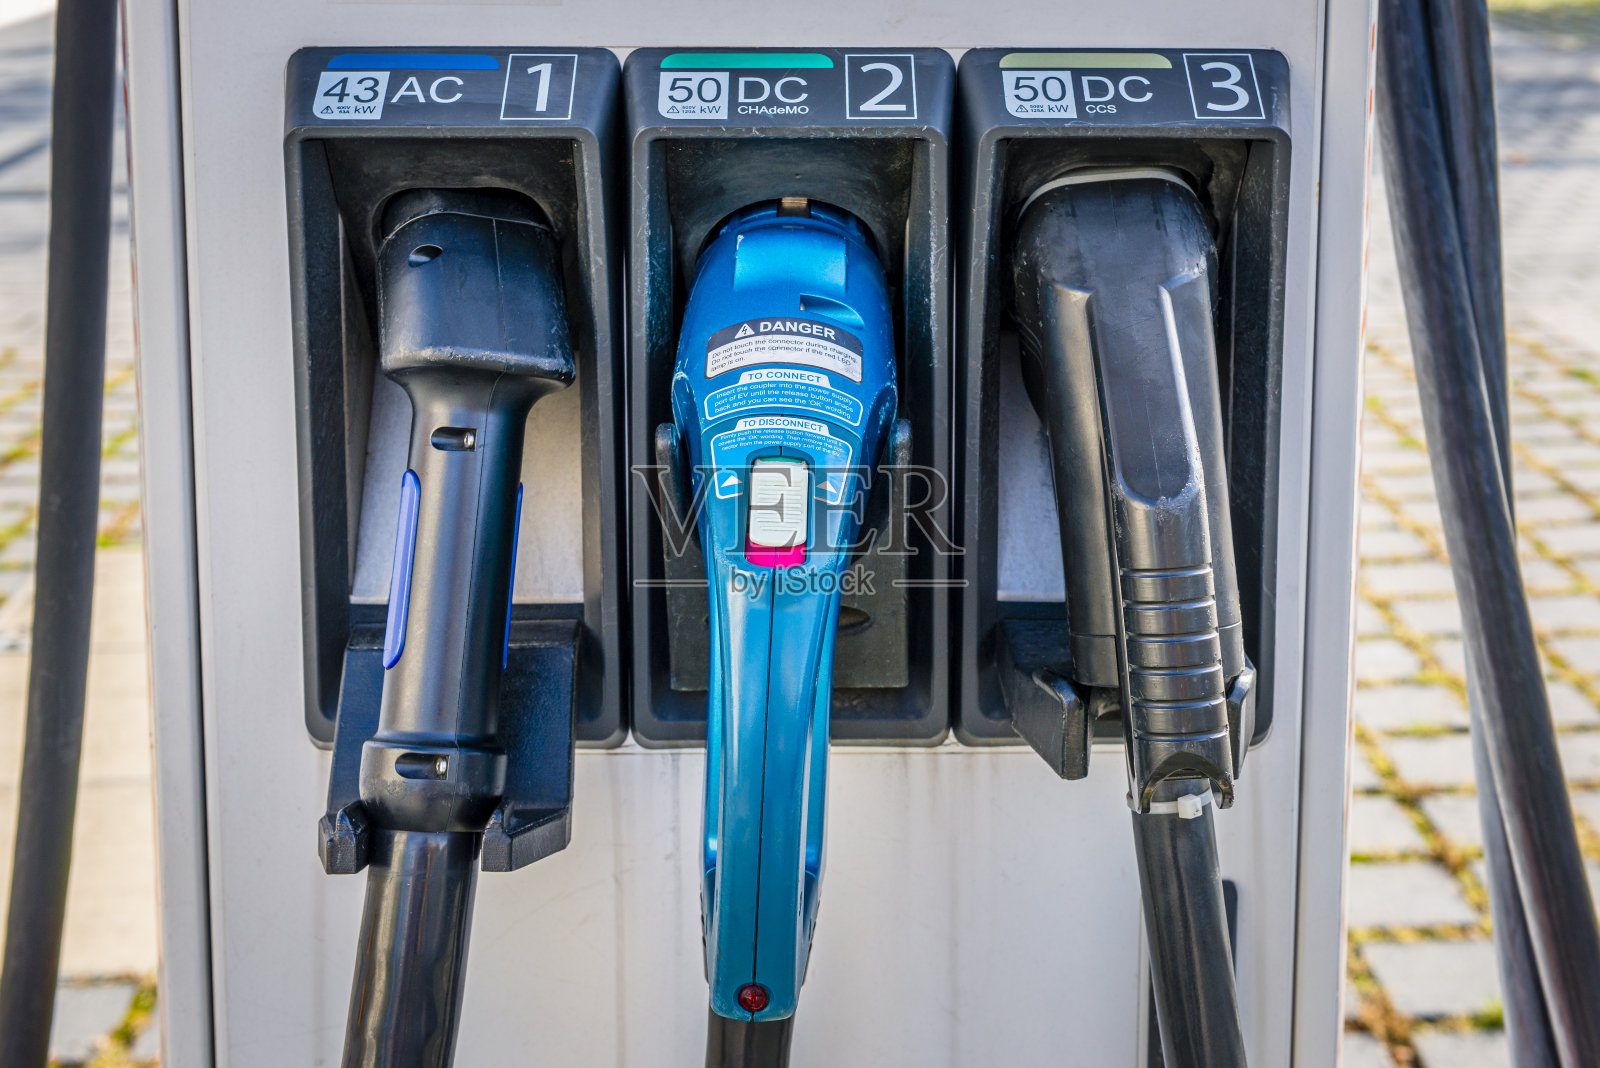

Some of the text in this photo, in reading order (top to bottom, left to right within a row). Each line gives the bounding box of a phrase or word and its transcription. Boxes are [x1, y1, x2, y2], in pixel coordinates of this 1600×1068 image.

[322, 76, 380, 102] 43
[390, 76, 464, 103] AC
[526, 63, 552, 112] 1
[668, 77, 722, 102] 50
[738, 76, 808, 103] DC
[860, 62, 907, 112] 2
[1013, 76, 1067, 102] 50
[1081, 76, 1153, 102] DC
[1200, 62, 1250, 112] 3
[354, 105, 377, 114] kW
[700, 105, 721, 113] kW
[738, 105, 809, 114] CHAdeMO
[1048, 104, 1069, 112] kW
[1086, 104, 1117, 114] CCS
[760, 321, 836, 340] DANGER
[734, 341, 753, 349] touch
[805, 341, 828, 350] during
[734, 348, 753, 357] touch
[824, 352, 836, 360] red
[748, 371, 821, 383] TO CONNECT
[714, 398, 728, 407] port
[782, 389, 809, 397] release
[811, 393, 833, 403] button
[834, 400, 854, 412] snaps
[716, 388, 735, 399] Insert
[750, 382, 777, 390] coupler
[808, 387, 830, 395] power
[832, 392, 853, 404] supply
[714, 403, 731, 413] back
[748, 397, 761, 405] you
[825, 405, 853, 419] wording.
[759, 419, 824, 432] DISCONNECT
